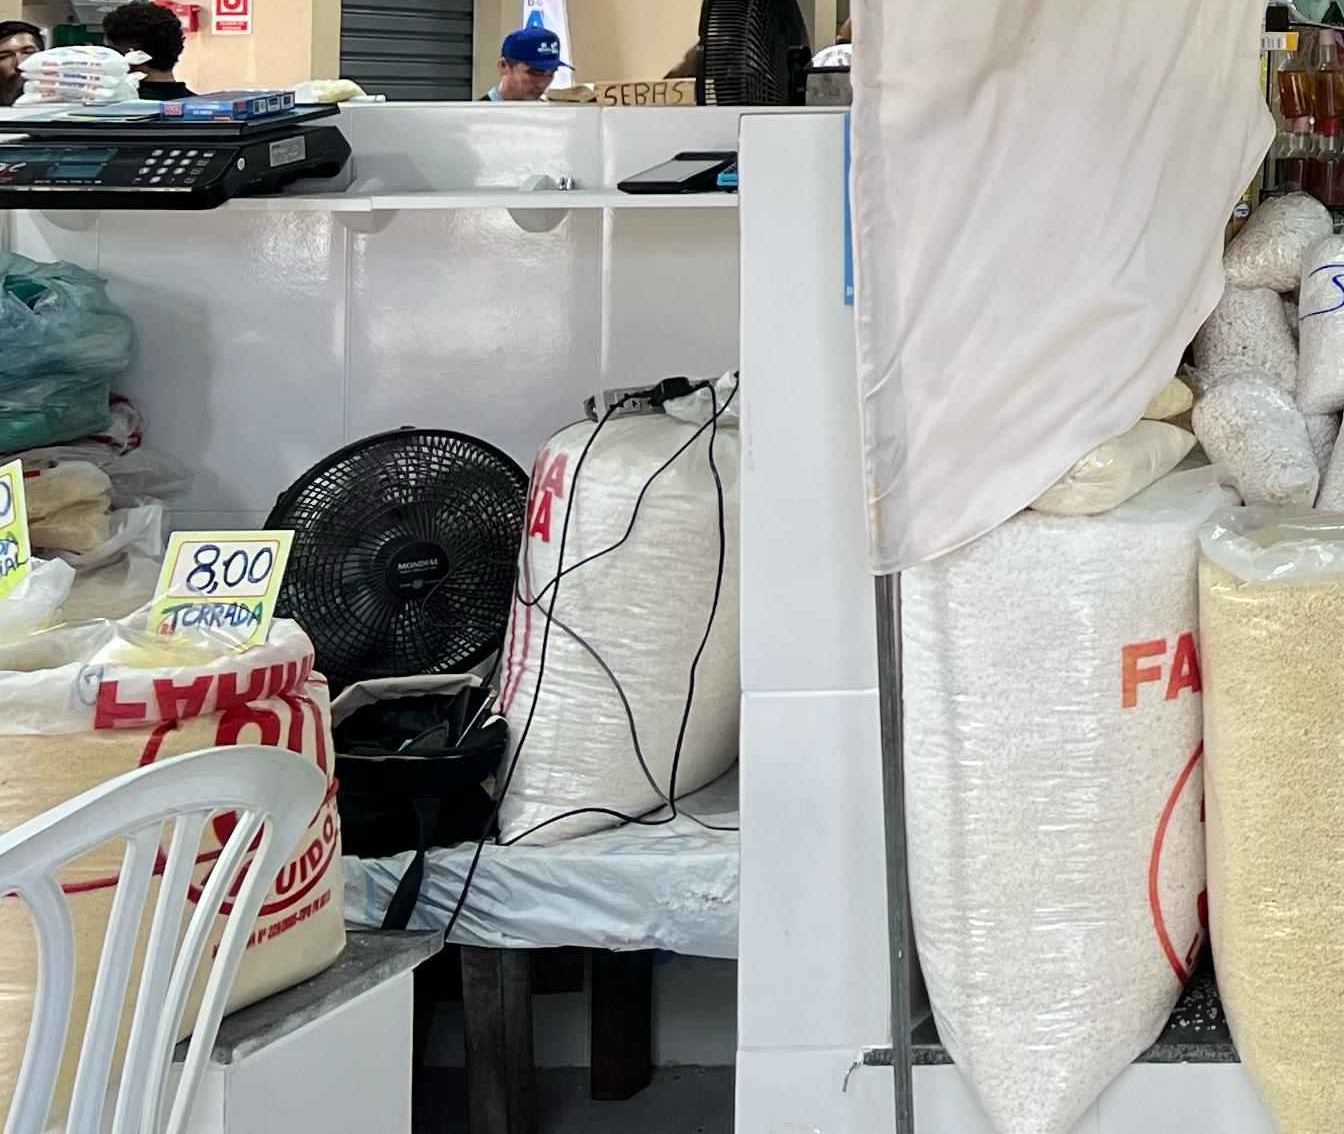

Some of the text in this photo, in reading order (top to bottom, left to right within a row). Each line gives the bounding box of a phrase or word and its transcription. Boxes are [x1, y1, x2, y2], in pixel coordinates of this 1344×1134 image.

[603, 82, 686, 107] SEBAS
[186, 544, 273, 594] 8,00
[161, 601, 263, 634] TORRADA
